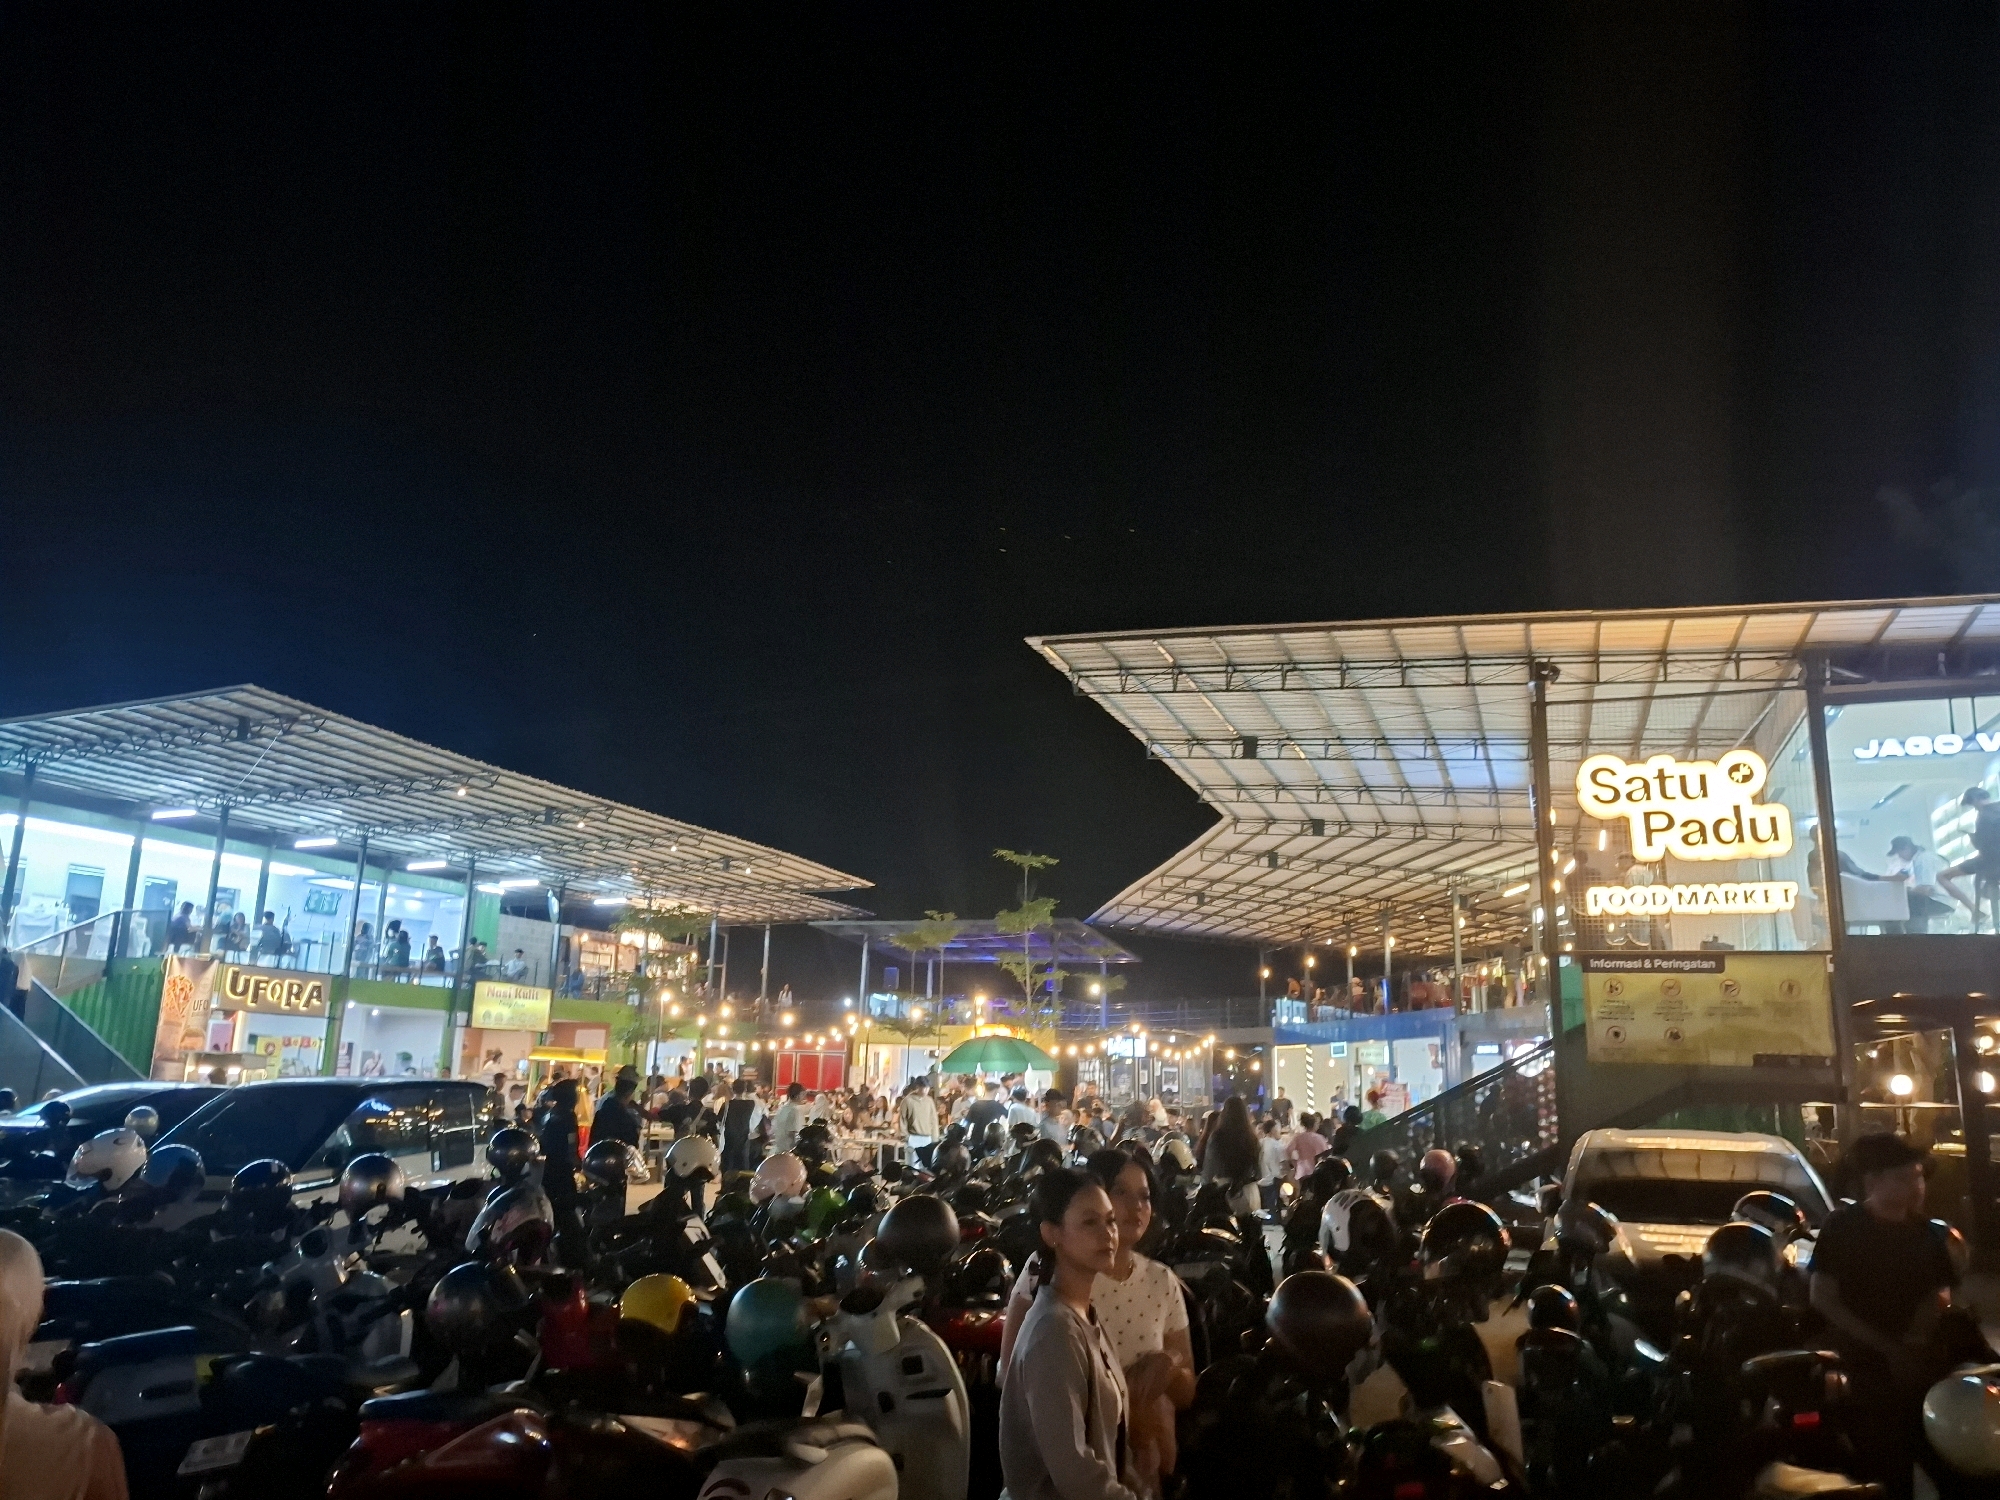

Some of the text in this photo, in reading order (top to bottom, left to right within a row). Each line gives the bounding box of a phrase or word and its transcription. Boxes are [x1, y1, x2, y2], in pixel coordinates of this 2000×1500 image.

[1587, 766, 1710, 806] Satu
[1641, 804, 1781, 848] Padu
[1590, 886, 1795, 911] FOOD MARKET
[1589, 958, 1716, 971] Informasi & Peringatan
[225, 966, 323, 1012] UFORA
